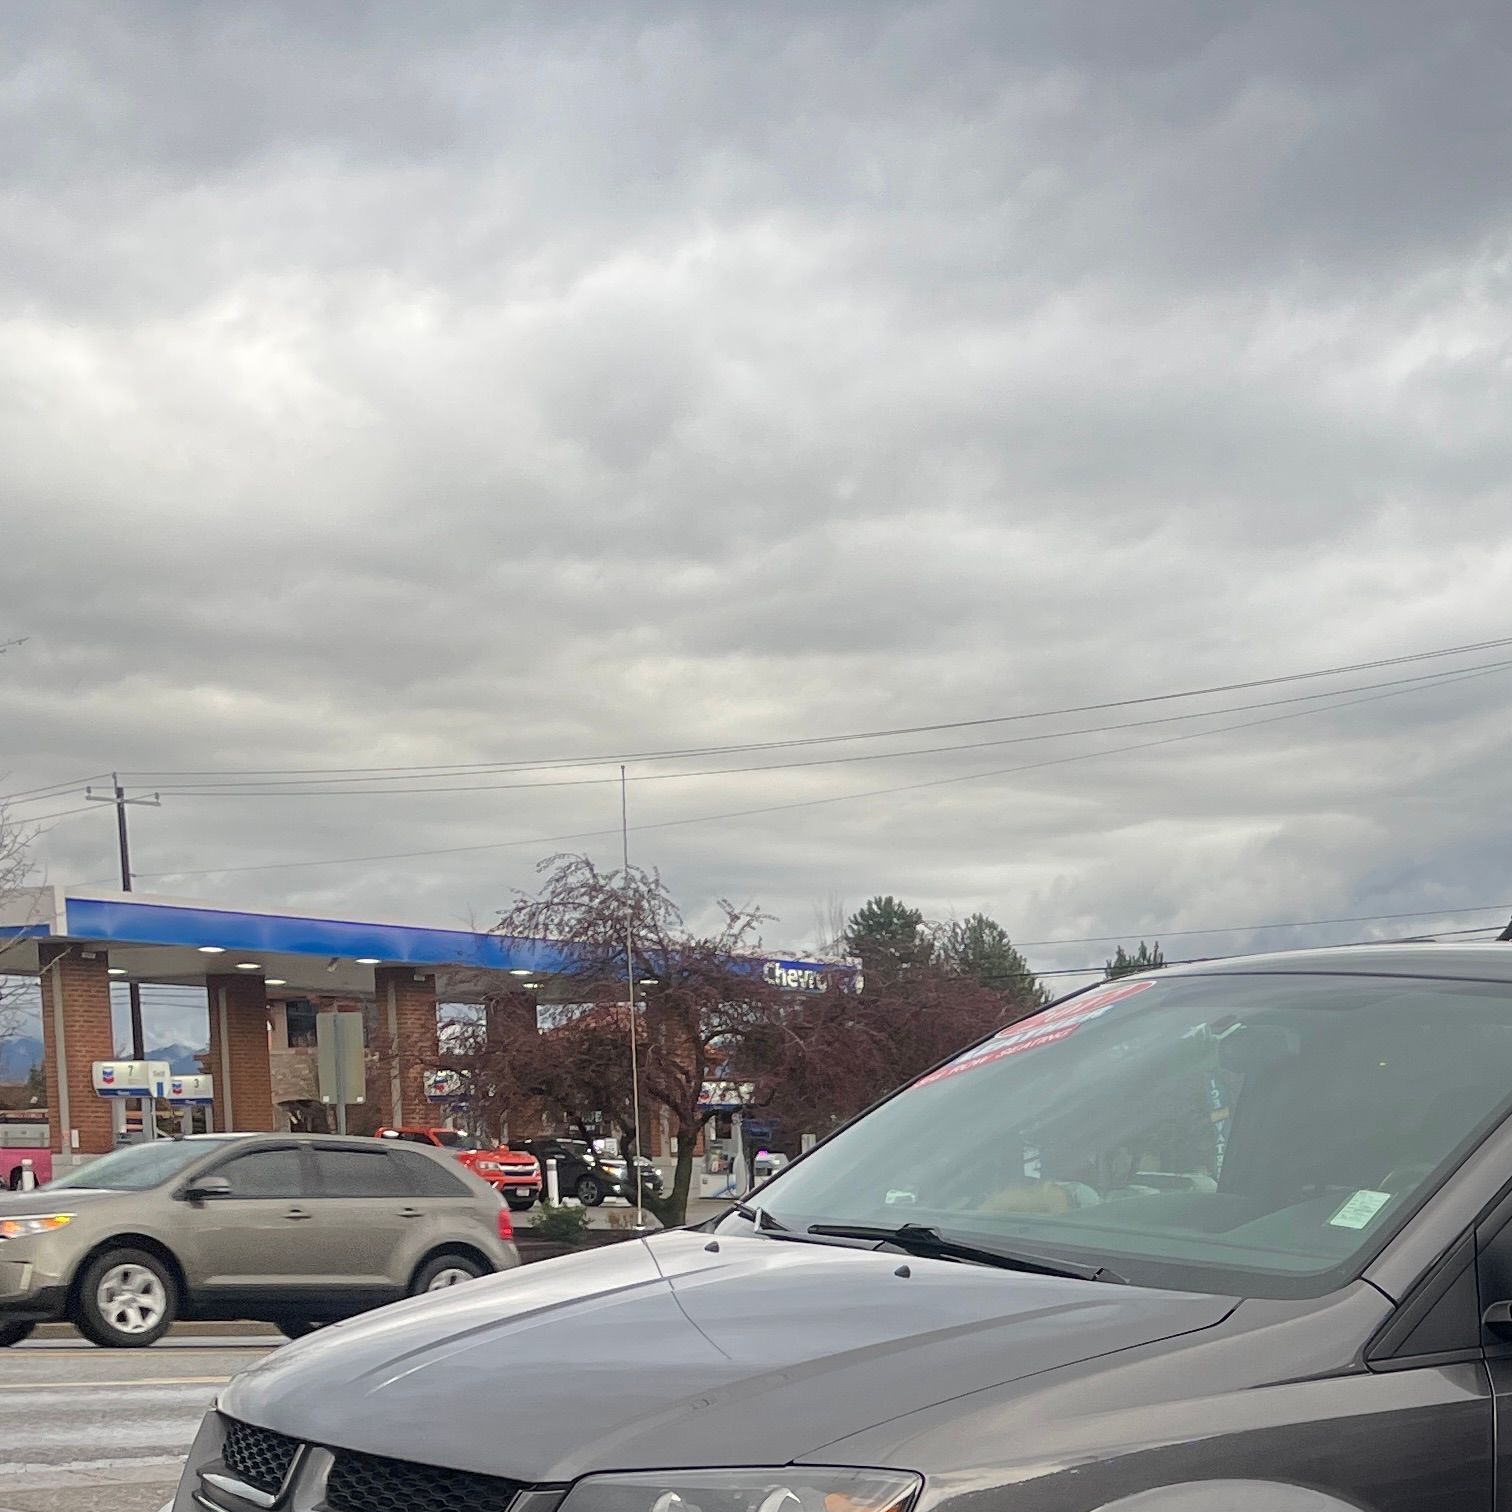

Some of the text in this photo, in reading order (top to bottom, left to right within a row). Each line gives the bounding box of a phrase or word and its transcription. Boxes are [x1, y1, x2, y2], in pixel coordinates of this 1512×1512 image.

[762, 961, 832, 993] Chevro
[127, 1065, 134, 1076] 7
[193, 1079, 200, 1088] 3
